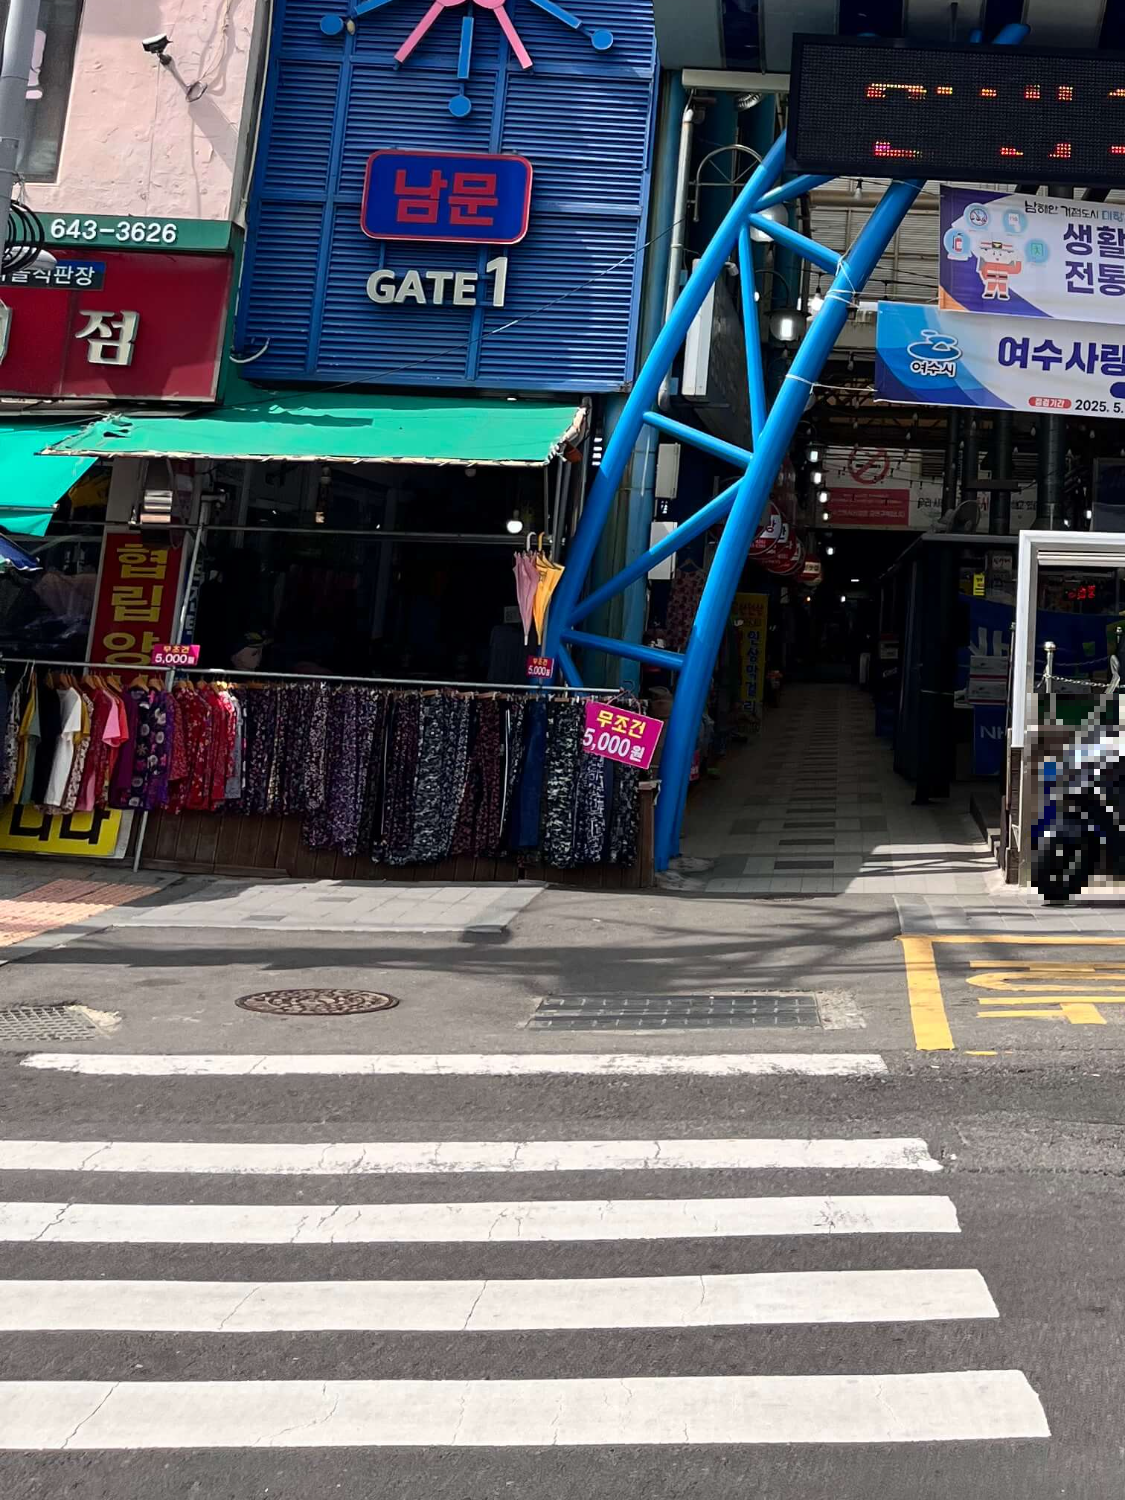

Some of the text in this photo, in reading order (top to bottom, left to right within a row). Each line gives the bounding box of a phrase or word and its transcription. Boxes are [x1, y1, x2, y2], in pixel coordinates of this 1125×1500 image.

[394, 169, 498, 226] 남문
[50, 218, 177, 243] 643-3626
[366, 256, 508, 307] GATE 1
[75, 309, 140, 367] 점
[911, 360, 957, 377] 여수시
[1074, 399, 1110, 413] 2025.
[596, 709, 647, 739] 무조건
[582, 727, 646, 763] 5,000원
